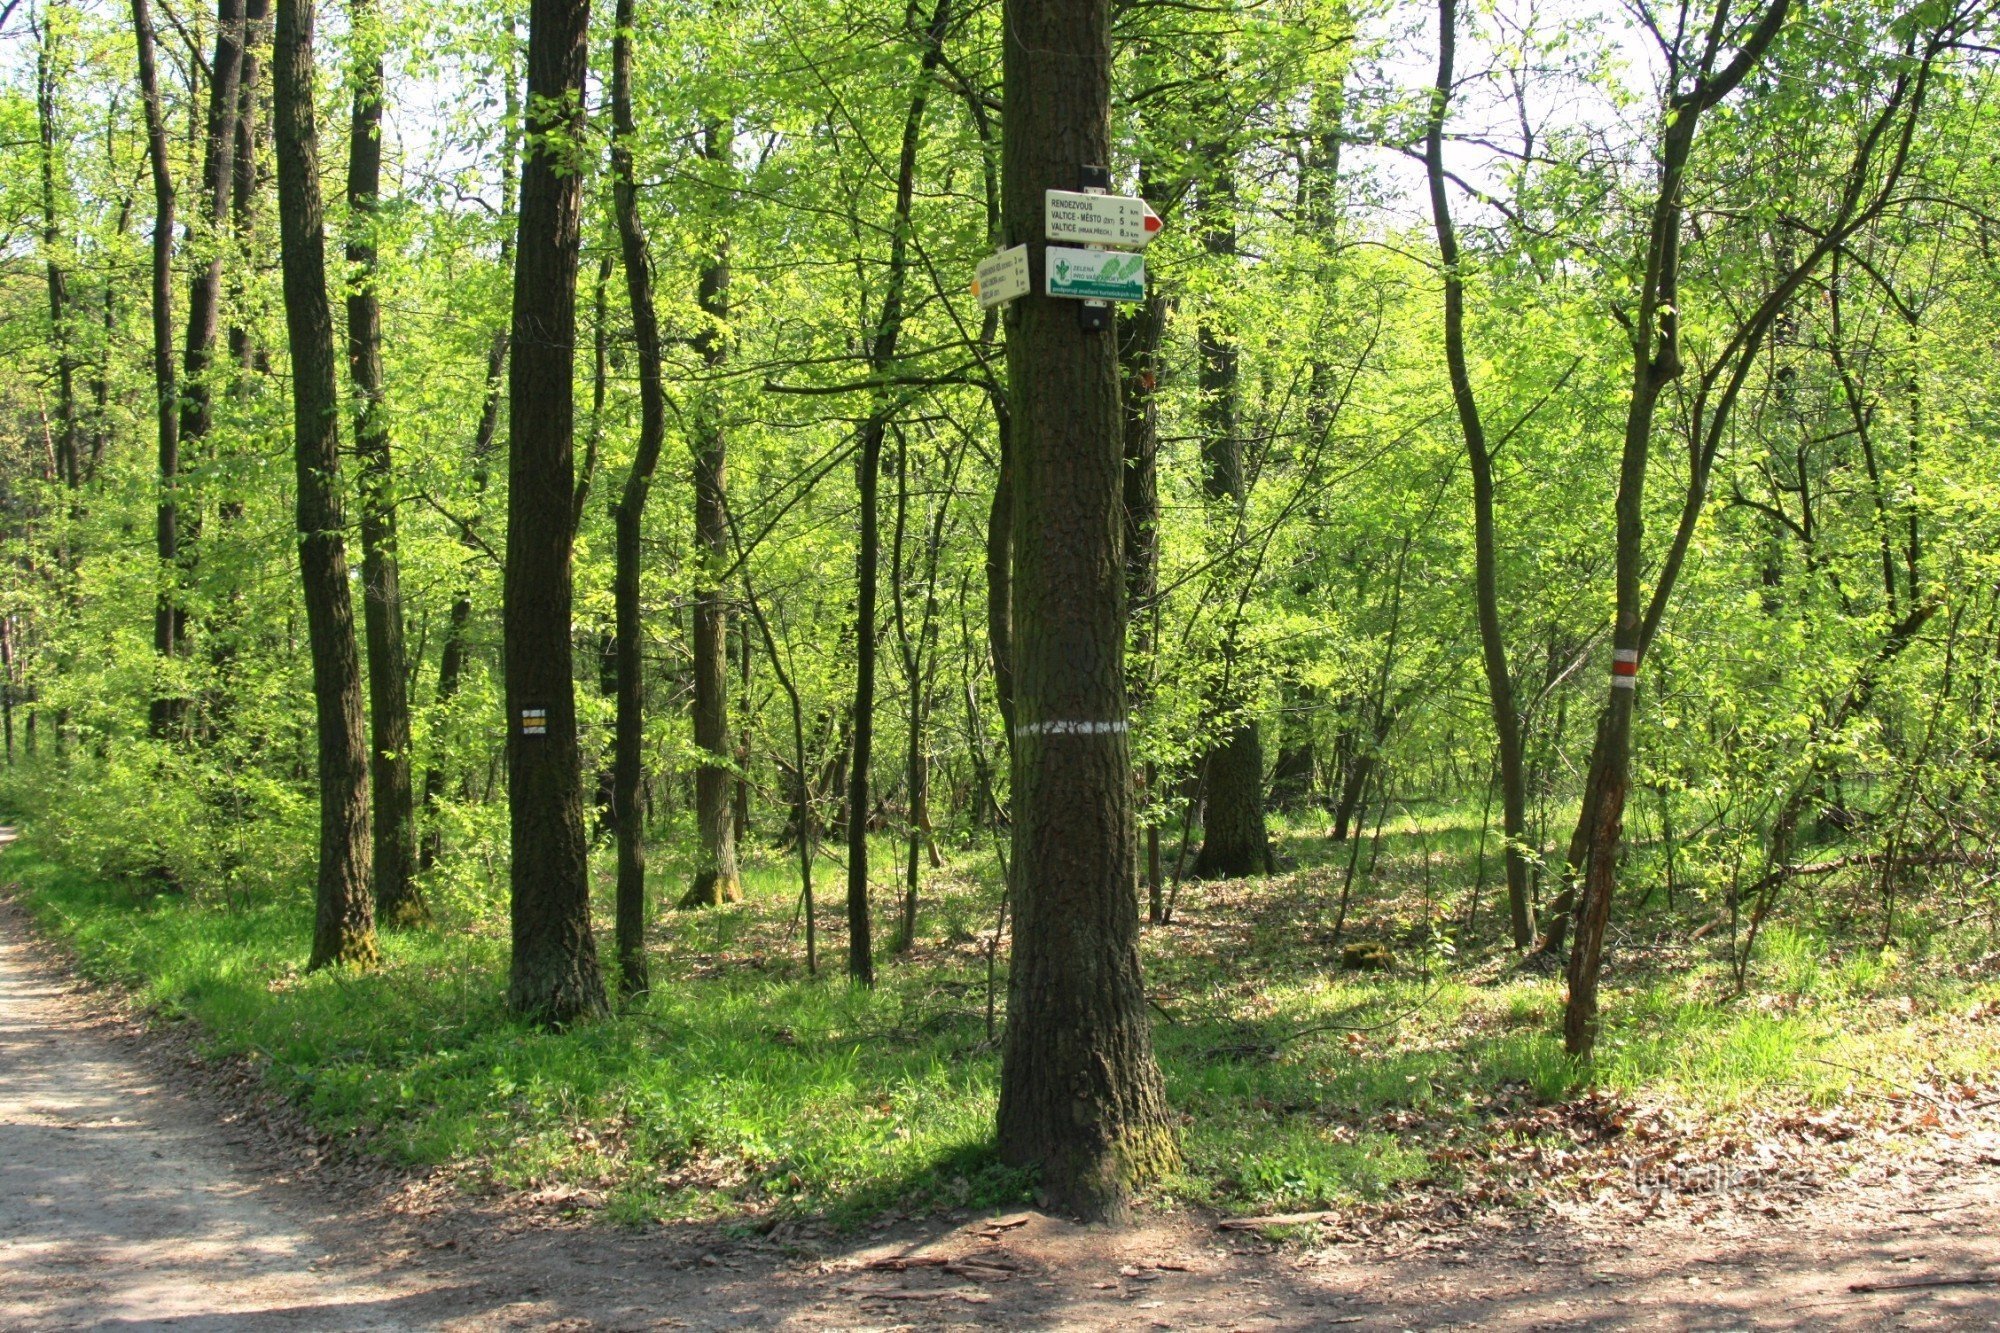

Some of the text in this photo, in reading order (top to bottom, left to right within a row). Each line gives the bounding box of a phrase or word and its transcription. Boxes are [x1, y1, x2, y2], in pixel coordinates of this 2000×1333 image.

[1051, 199, 1093, 211] RENDEZVOUS
[1119, 205, 1124, 214] 2
[1051, 211, 1076, 221] VALTICE
[1080, 212, 1102, 223] MĚSTO
[1119, 217, 1125, 225] 5
[1051, 222, 1077, 233] VALTICE
